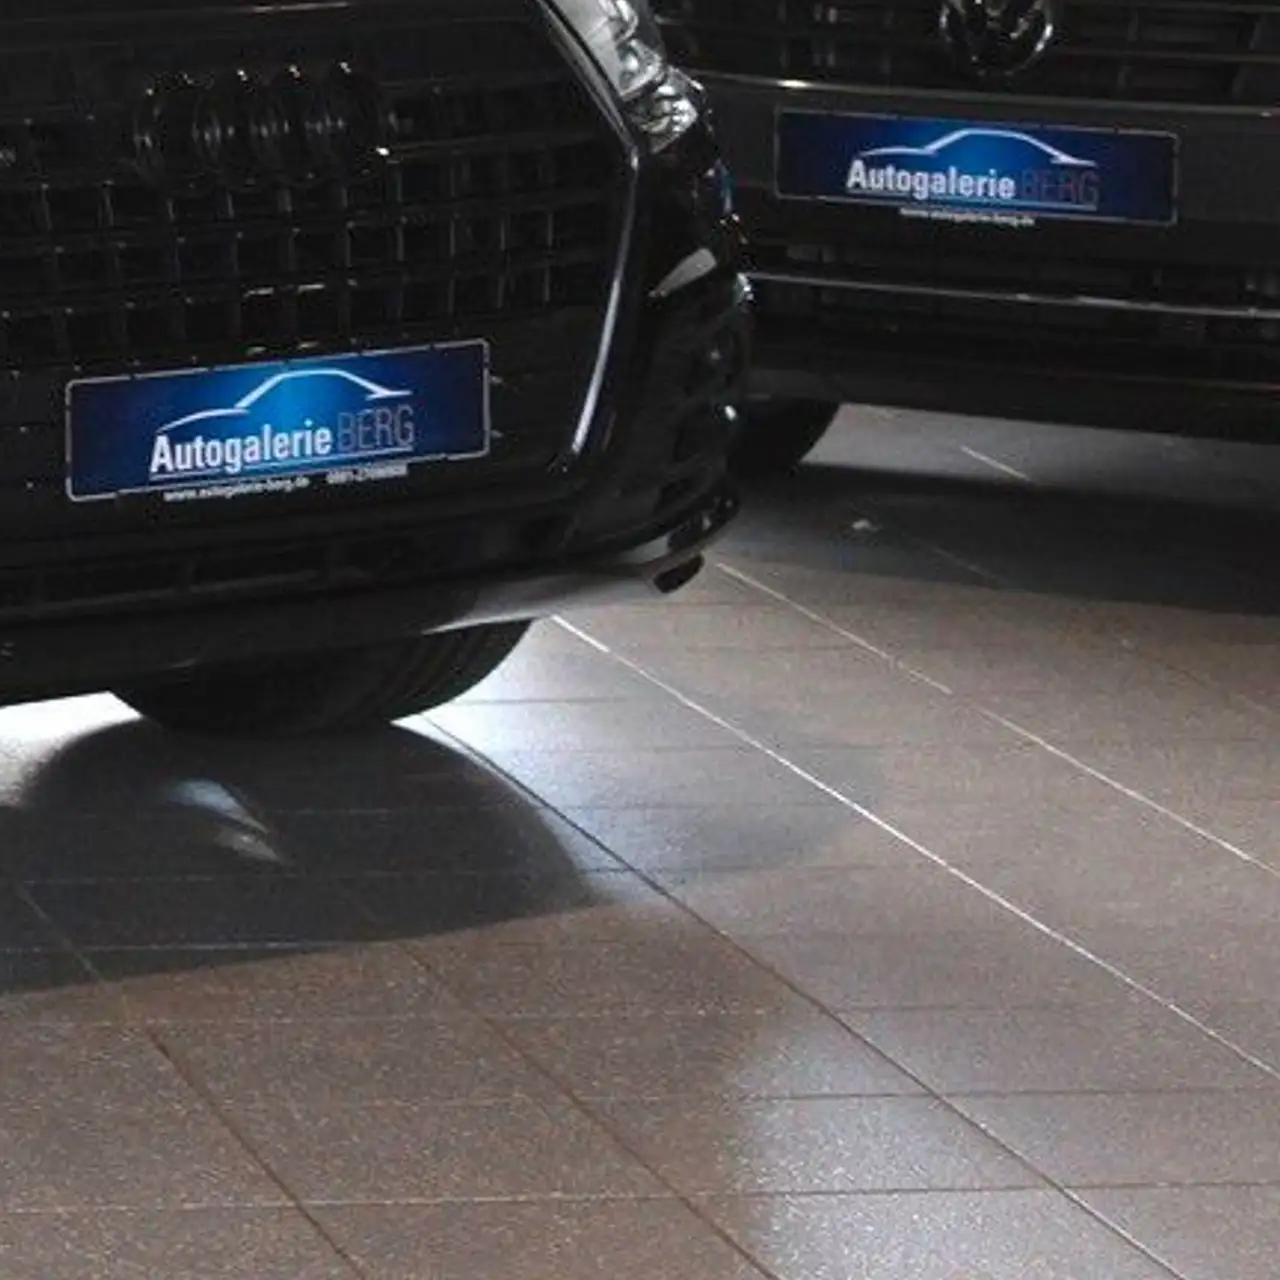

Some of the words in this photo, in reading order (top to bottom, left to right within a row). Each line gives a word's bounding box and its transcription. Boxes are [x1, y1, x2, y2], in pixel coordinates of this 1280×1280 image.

[847, 159, 1016, 201] Autogalerie
[1022, 170, 1100, 205] BERG
[151, 420, 332, 473] Autogalerie
[337, 404, 415, 451] BERG
